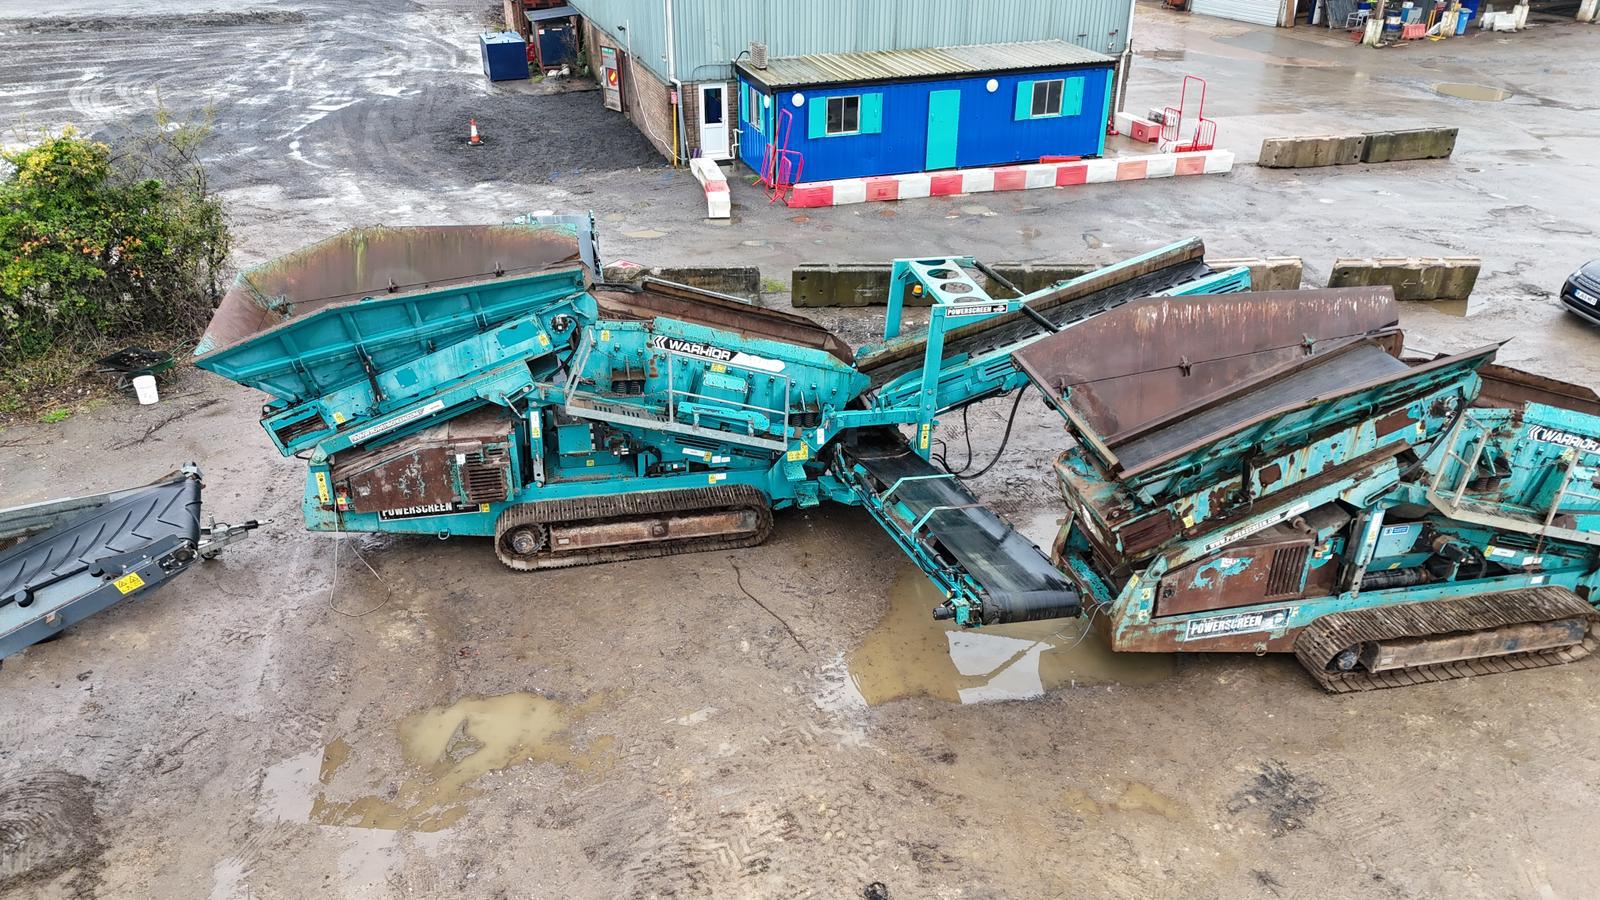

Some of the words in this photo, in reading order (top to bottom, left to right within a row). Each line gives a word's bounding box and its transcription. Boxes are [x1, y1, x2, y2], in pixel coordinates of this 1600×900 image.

[948, 305, 993, 315] POWERSCREEN
[1541, 428, 1599, 451] WARRIOR
[382, 502, 453, 517] POWERSCREEN
[1190, 615, 1263, 635] POWERSCREEN
